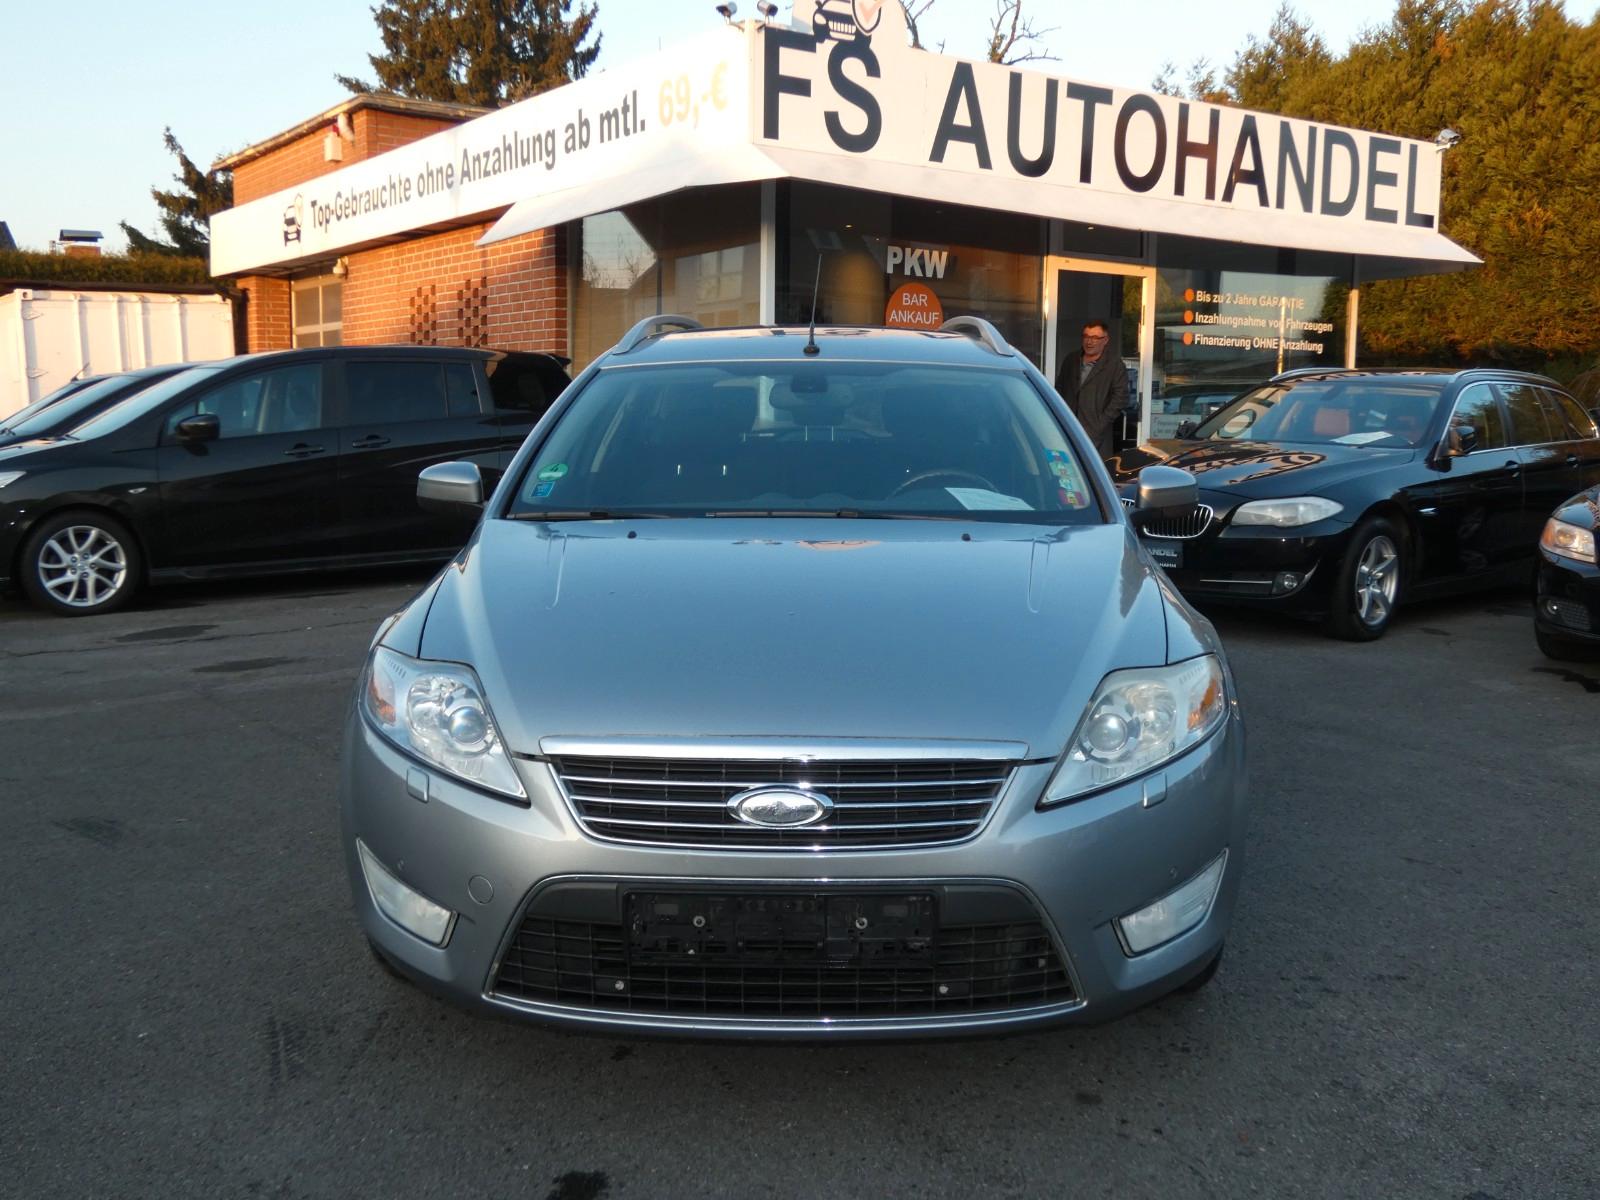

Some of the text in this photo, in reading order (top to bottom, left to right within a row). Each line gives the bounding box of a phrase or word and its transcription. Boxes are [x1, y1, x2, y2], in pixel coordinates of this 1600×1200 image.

[763, 26, 1434, 229] FS AUTOHANDEL
[310, 173, 412, 233] Top-Gebrauchte
[417, 161, 455, 198] ohne
[460, 127, 556, 185] Anzahlung
[564, 109, 591, 154] ab
[599, 89, 646, 144] mtl.
[886, 245, 948, 279] PKW
[902, 293, 928, 307] BAR
[1196, 290, 1211, 303] Bis
[1212, 293, 1224, 303] zu
[1226, 293, 1232, 304] 2
[1233, 294, 1257, 306] Jahre
[889, 309, 940, 325] ANKAUF
[1195, 311, 1266, 328] Inzahlungnahme
[1285, 318, 1333, 334] Fahrzeugen
[1194, 333, 1251, 351] Finanzierung
[1253, 336, 1278, 349] OHNE
